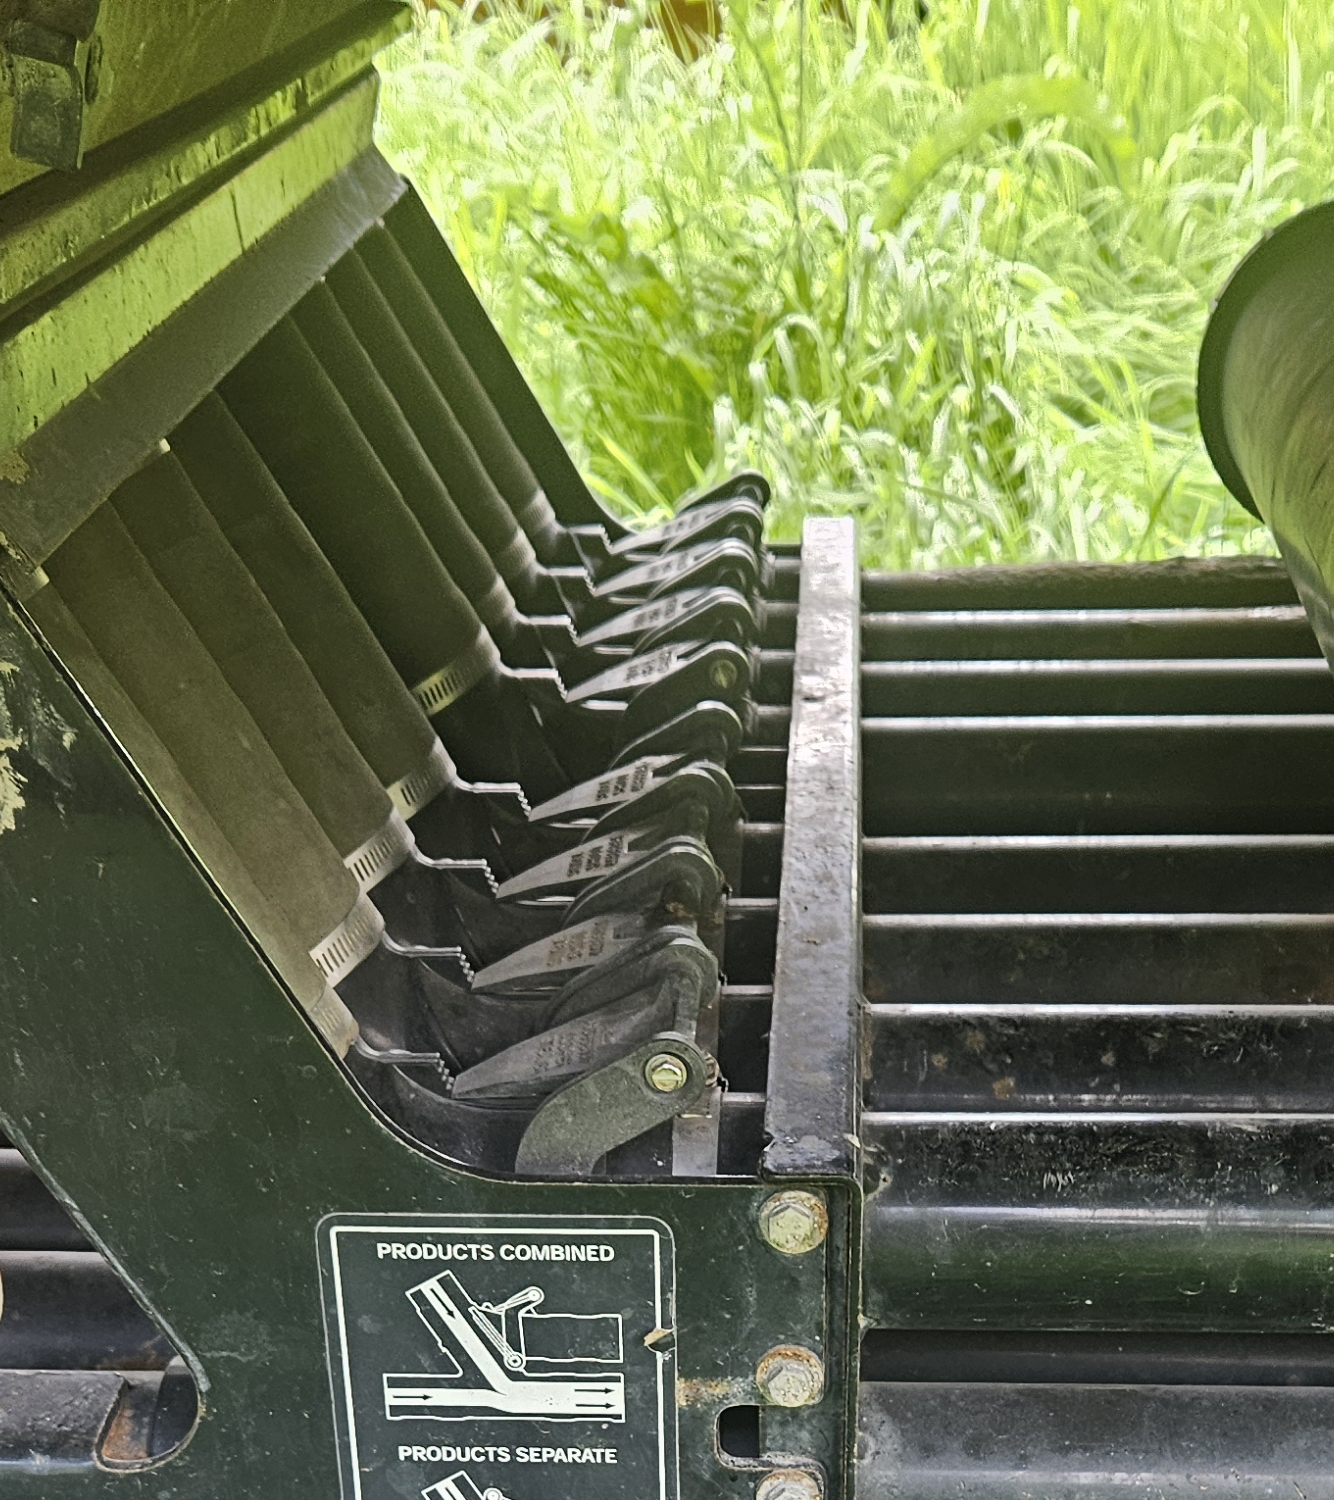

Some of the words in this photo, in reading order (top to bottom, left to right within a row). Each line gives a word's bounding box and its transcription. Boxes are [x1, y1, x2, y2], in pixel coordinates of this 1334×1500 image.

[376, 1242, 495, 1261] PRODUCTS
[499, 1244, 615, 1262] COMBINED
[398, 1445, 511, 1462] PRODUCTS
[515, 1447, 618, 1464] SEPARATE
